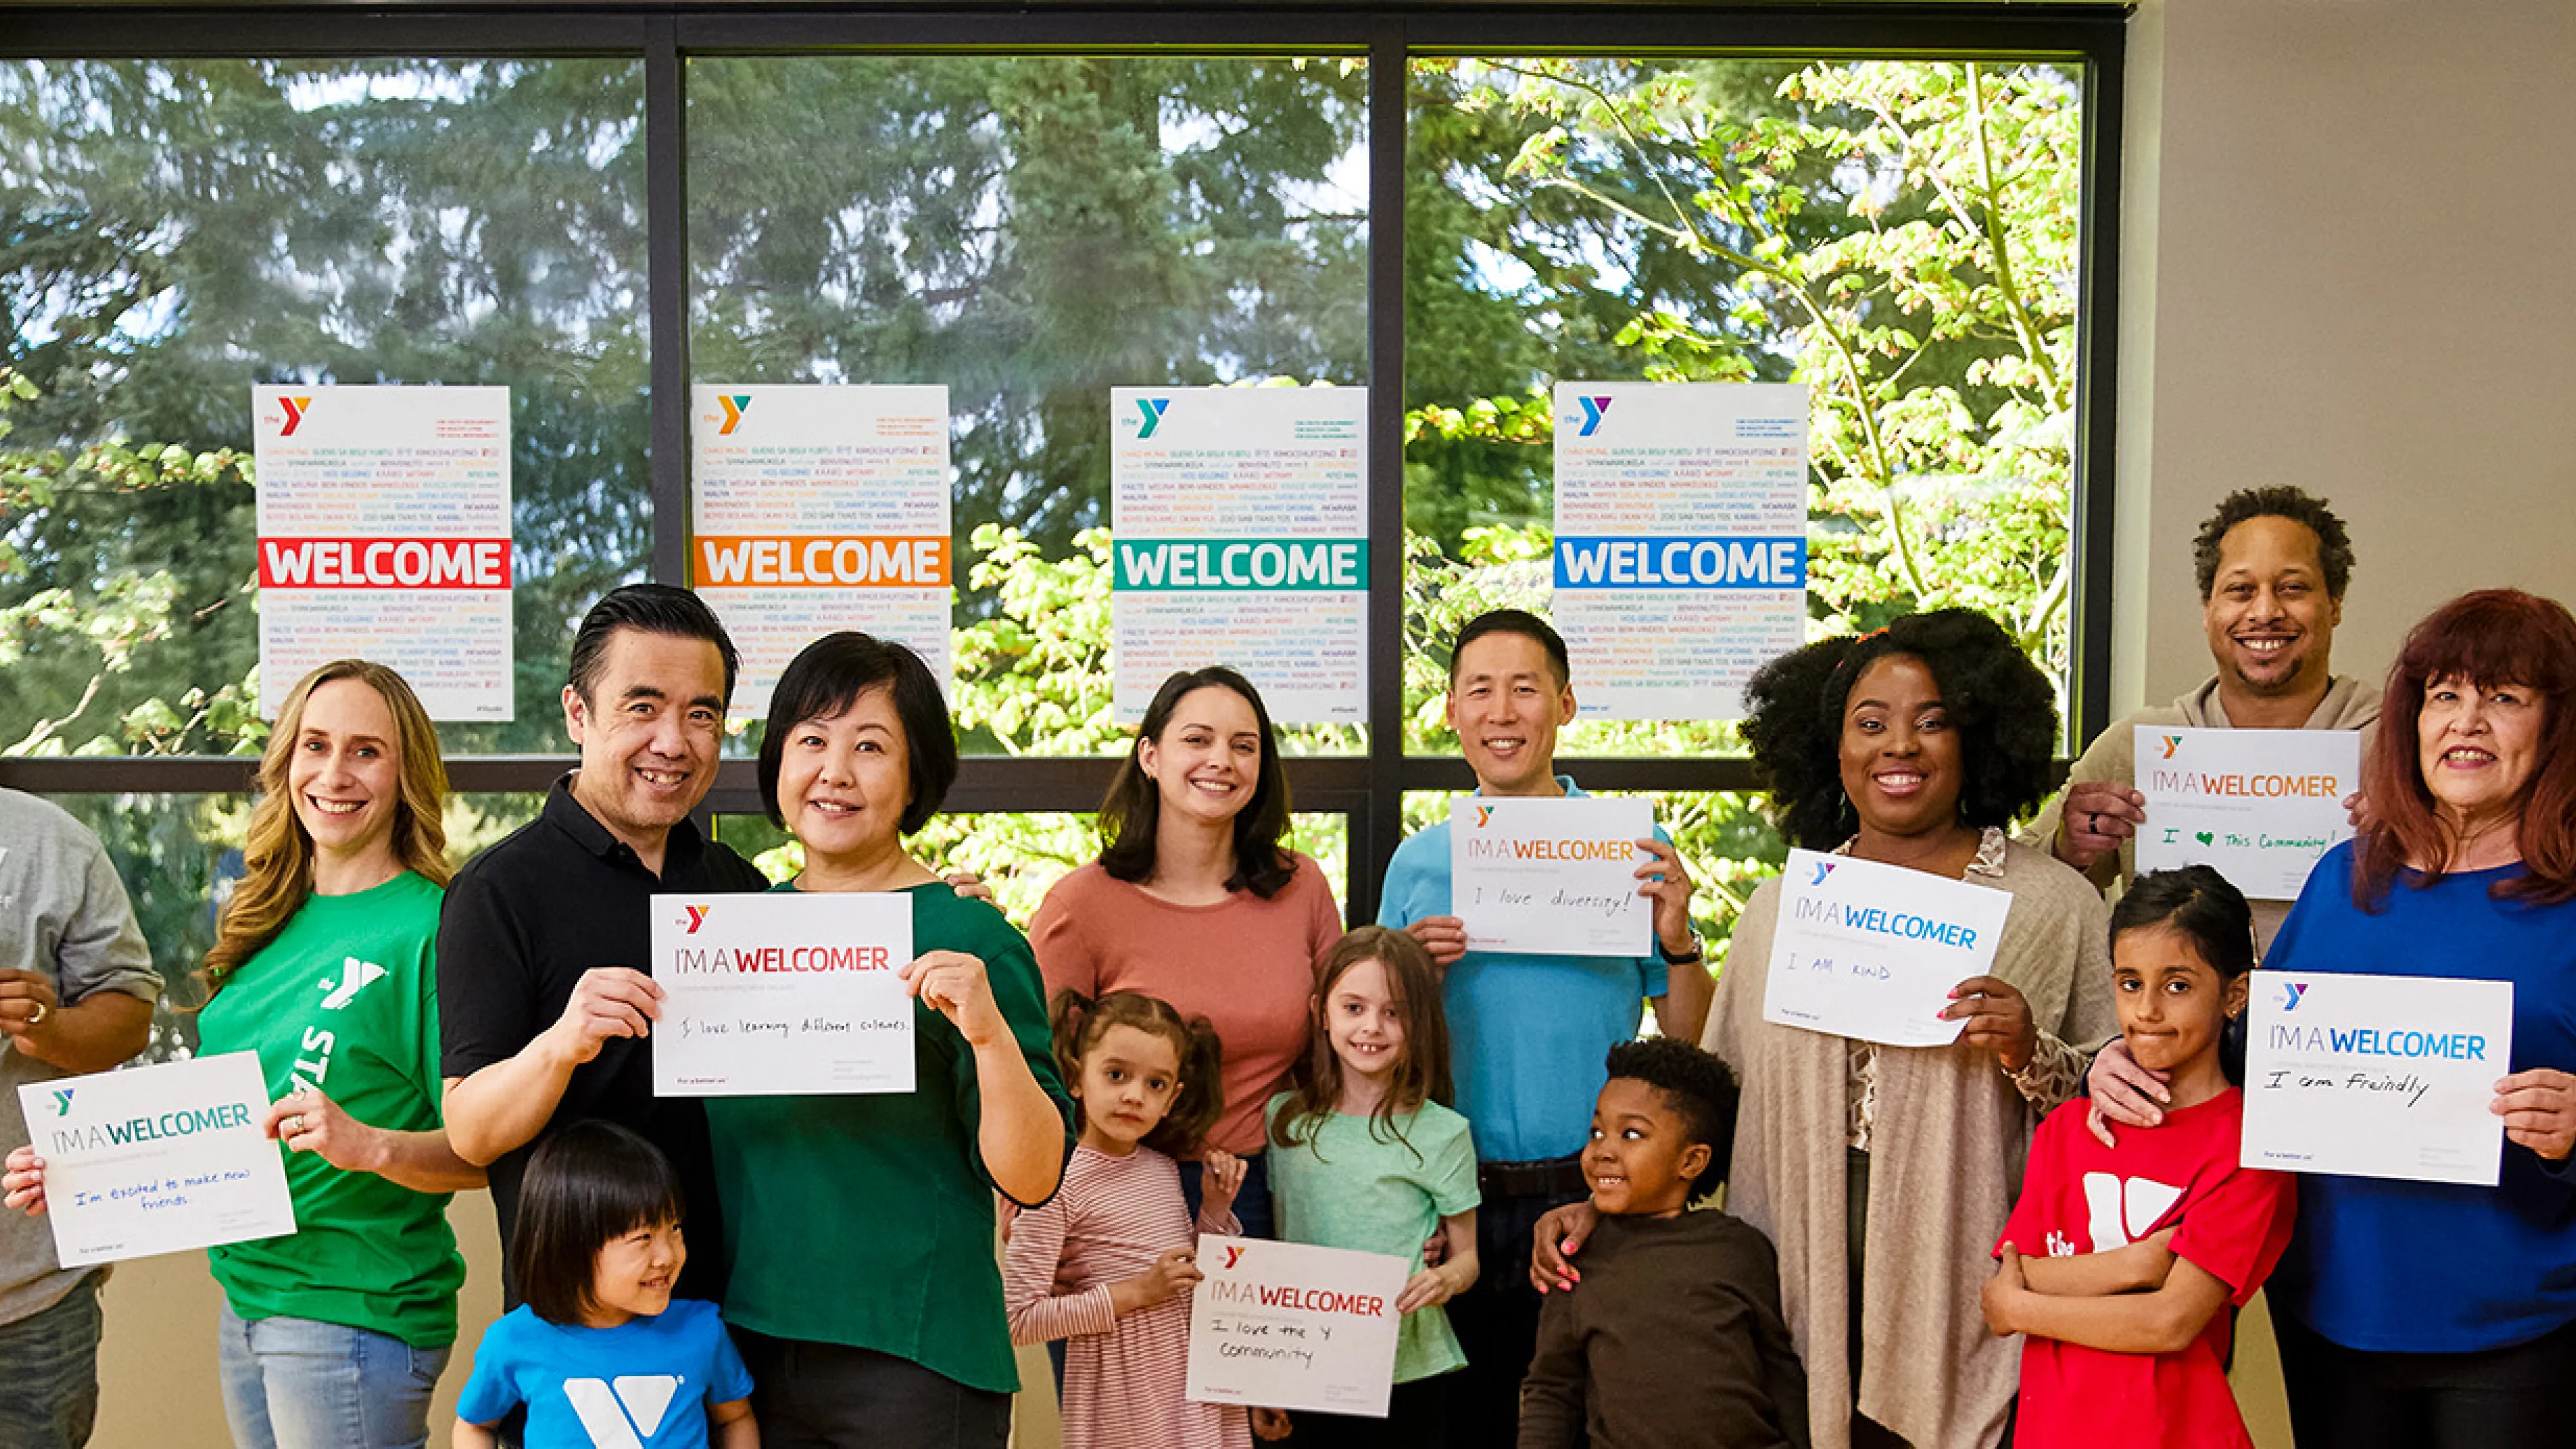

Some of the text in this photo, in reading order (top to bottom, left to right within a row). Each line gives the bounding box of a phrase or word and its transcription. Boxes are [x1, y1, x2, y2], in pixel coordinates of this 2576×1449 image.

[265, 541, 502, 584] WELCOME
[704, 539, 941, 583] WELCOME
[1121, 543, 1358, 586] WELCOME
[1561, 541, 1797, 584] WELCOME
[2182, 773, 2198, 793] A
[2201, 773, 2338, 797] WELCOMER
[1496, 839, 1511, 857] A
[1513, 839, 1635, 861] WELCOMER
[2162, 828, 2180, 843] I
[2225, 833, 2251, 847] This
[1475, 886, 1483, 904] I
[1499, 888, 1532, 905] love
[1823, 902, 1839, 924] A
[1844, 904, 1977, 949] WELCOMER
[712, 948, 731, 973] A
[733, 946, 890, 972] WELCOMER
[1788, 953, 1891, 981] I AM KIND
[680, 1016, 691, 1038] I
[700, 1018, 730, 1034] love
[739, 1018, 791, 1038] learning
[2305, 1026, 2325, 1052] A
[2329, 1027, 2486, 1061] WELCOMER
[2263, 1071, 2291, 1089] I
[2298, 1075, 2334, 1088] am
[89, 1126, 106, 1149] A
[105, 1102, 252, 1146] WELCOMER
[110, 1179, 158, 1199] excited
[184, 1173, 219, 1186] make
[224, 1169, 250, 1180] new
[1240, 1283, 1255, 1305] A
[1258, 1284, 1383, 1318] WELCOMER
[1210, 1319, 1228, 1333] I
[1236, 1321, 1269, 1336] love
[1279, 1324, 1305, 1339] the
